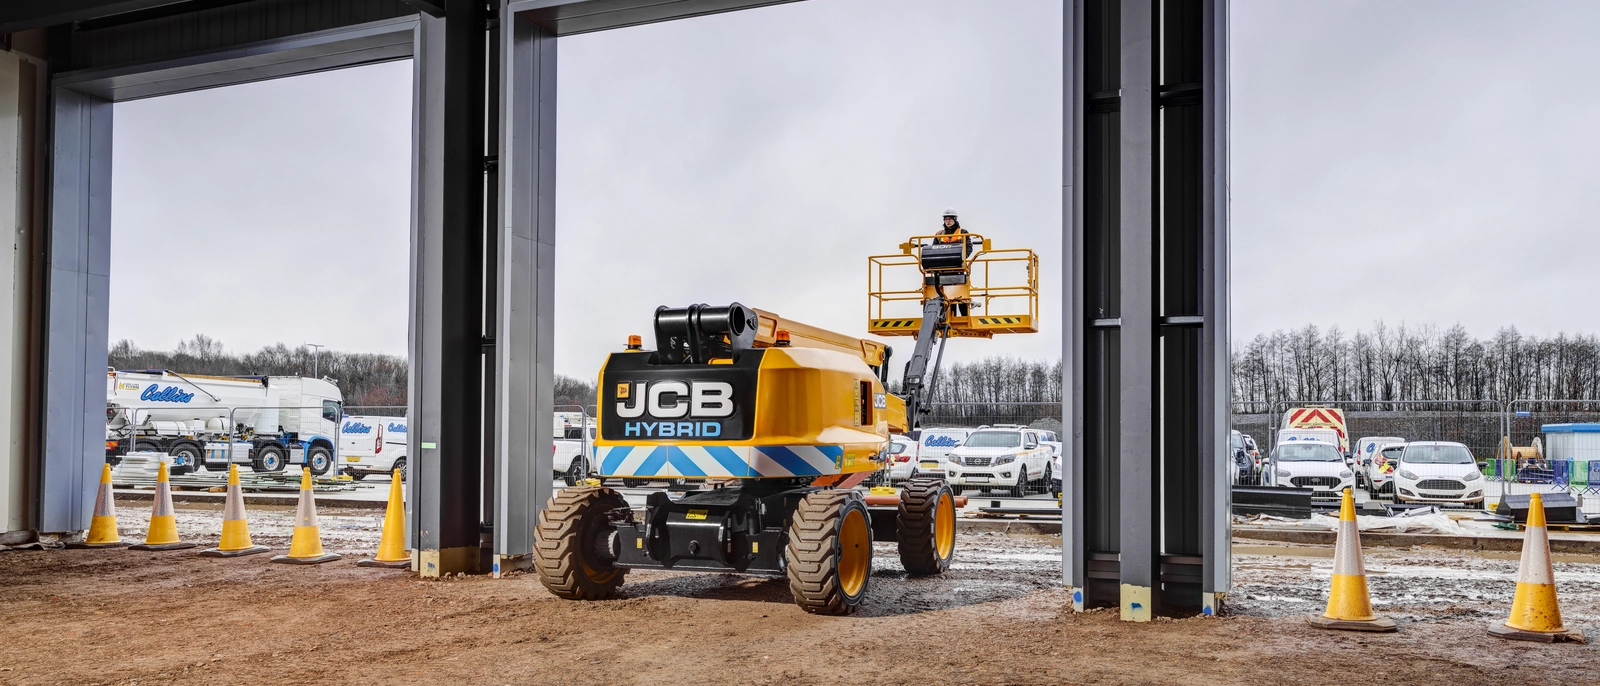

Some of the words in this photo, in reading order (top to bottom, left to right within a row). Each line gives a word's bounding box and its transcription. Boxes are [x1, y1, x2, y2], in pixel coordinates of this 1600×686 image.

[141, 384, 194, 403] Collins
[616, 382, 734, 418] JCB
[874, 393, 886, 408] JCB
[341, 421, 372, 434] Collins
[387, 422, 407, 433] Colli
[625, 422, 722, 437] HYBRID
